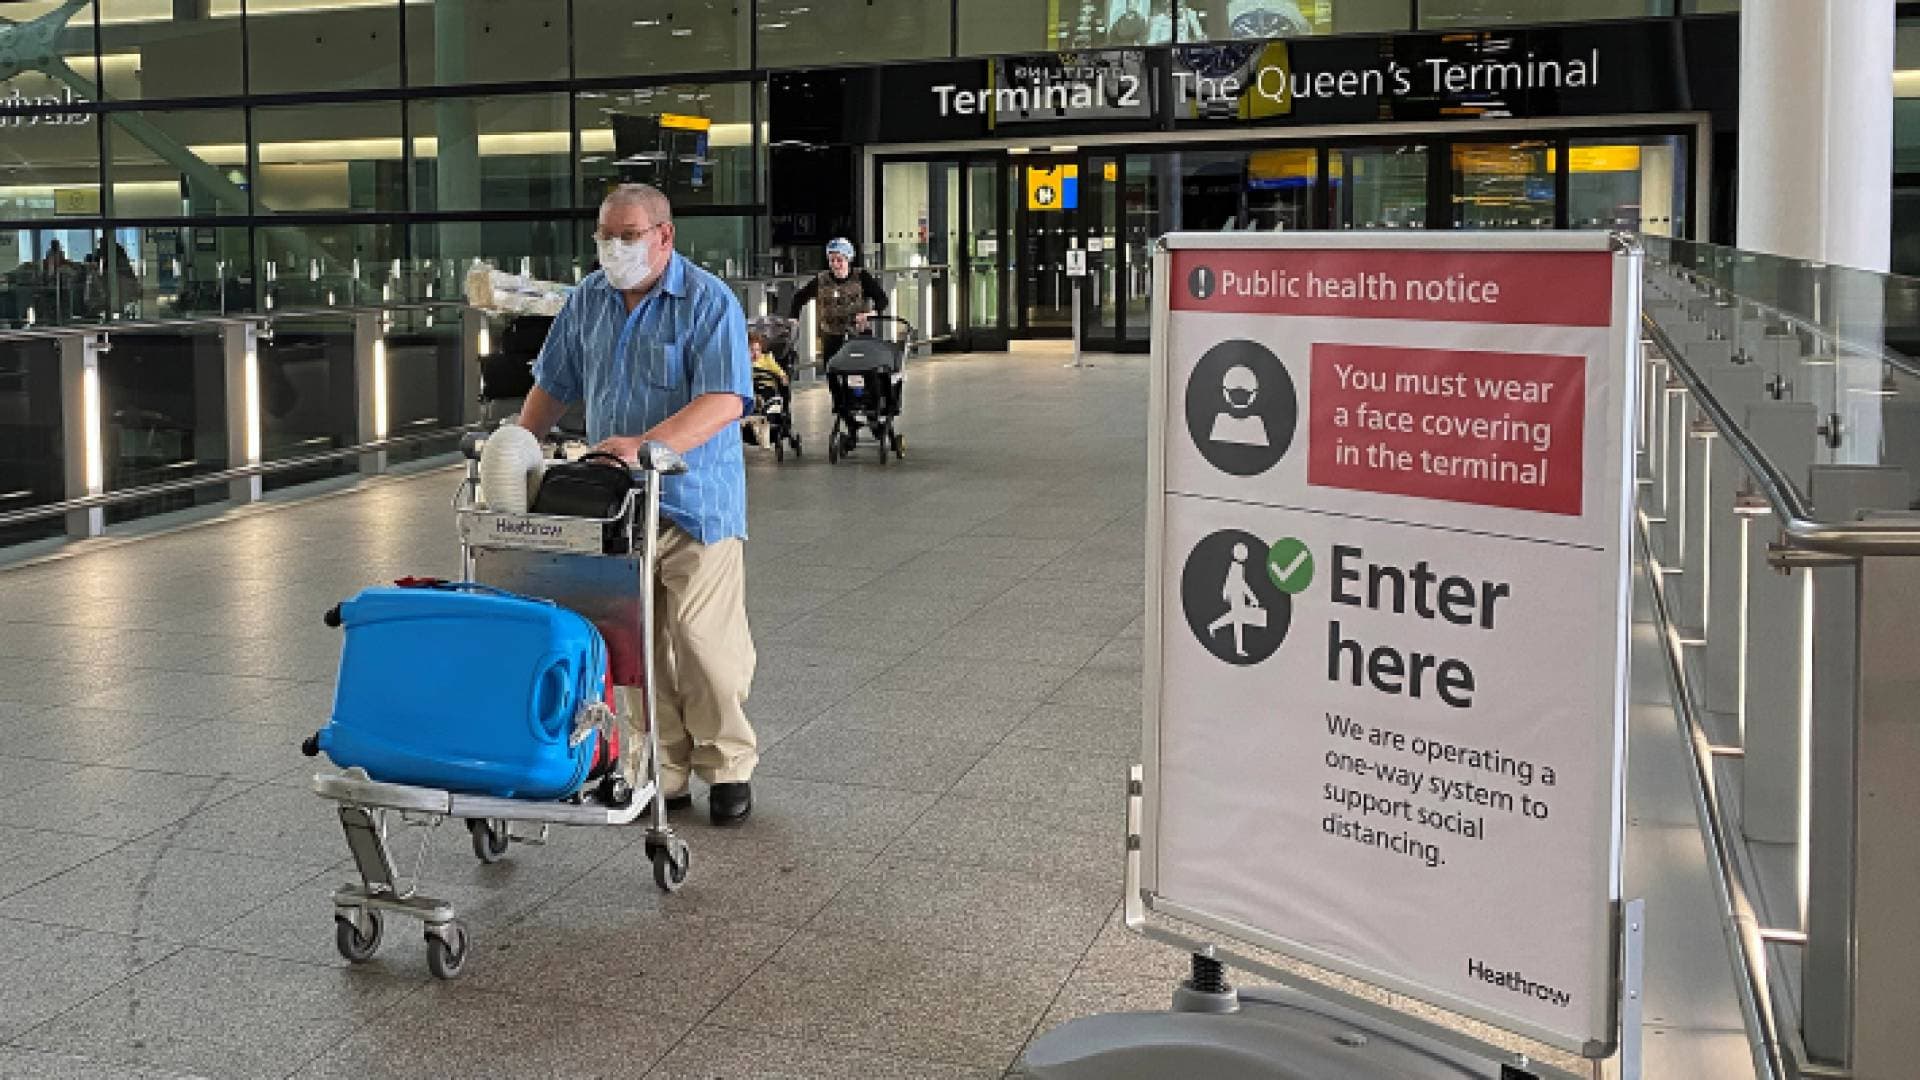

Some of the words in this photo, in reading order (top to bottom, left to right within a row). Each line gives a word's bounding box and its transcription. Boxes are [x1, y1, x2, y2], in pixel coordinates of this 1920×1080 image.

[931, 74, 1103, 116] Terminal
[1117, 74, 1141, 105] 2
[1171, 69, 1240, 105] The
[1257, 61, 1411, 103] Queen's
[1426, 48, 1599, 94] Terminal
[1222, 269, 1300, 298] Public
[1306, 271, 1397, 300] health
[1406, 273, 1500, 303] notice
[1333, 364, 1386, 392] You
[1395, 373, 1468, 398] must
[1474, 377, 1554, 403] wear
[1333, 407, 1349, 427] a
[1356, 401, 1413, 433] face
[1422, 412, 1551, 450] covering
[1336, 437, 1359, 465] in
[1365, 442, 1413, 471] the
[1421, 451, 1549, 487] terminal
[497, 517, 564, 537] Heathrow
[1330, 544, 1511, 630] Enter
[1328, 620, 1475, 709] here
[1325, 712, 1364, 741] We
[1368, 728, 1405, 752] are
[1411, 737, 1534, 787] operating
[1541, 766, 1556, 786] a
[1323, 781, 1414, 823] support
[1417, 806, 1484, 841] social
[1325, 749, 1424, 795] one-way
[1428, 776, 1513, 812] system
[1520, 793, 1549, 820] to
[1322, 813, 1446, 868] distancing.
[1468, 957, 1571, 1008] Heathrow
